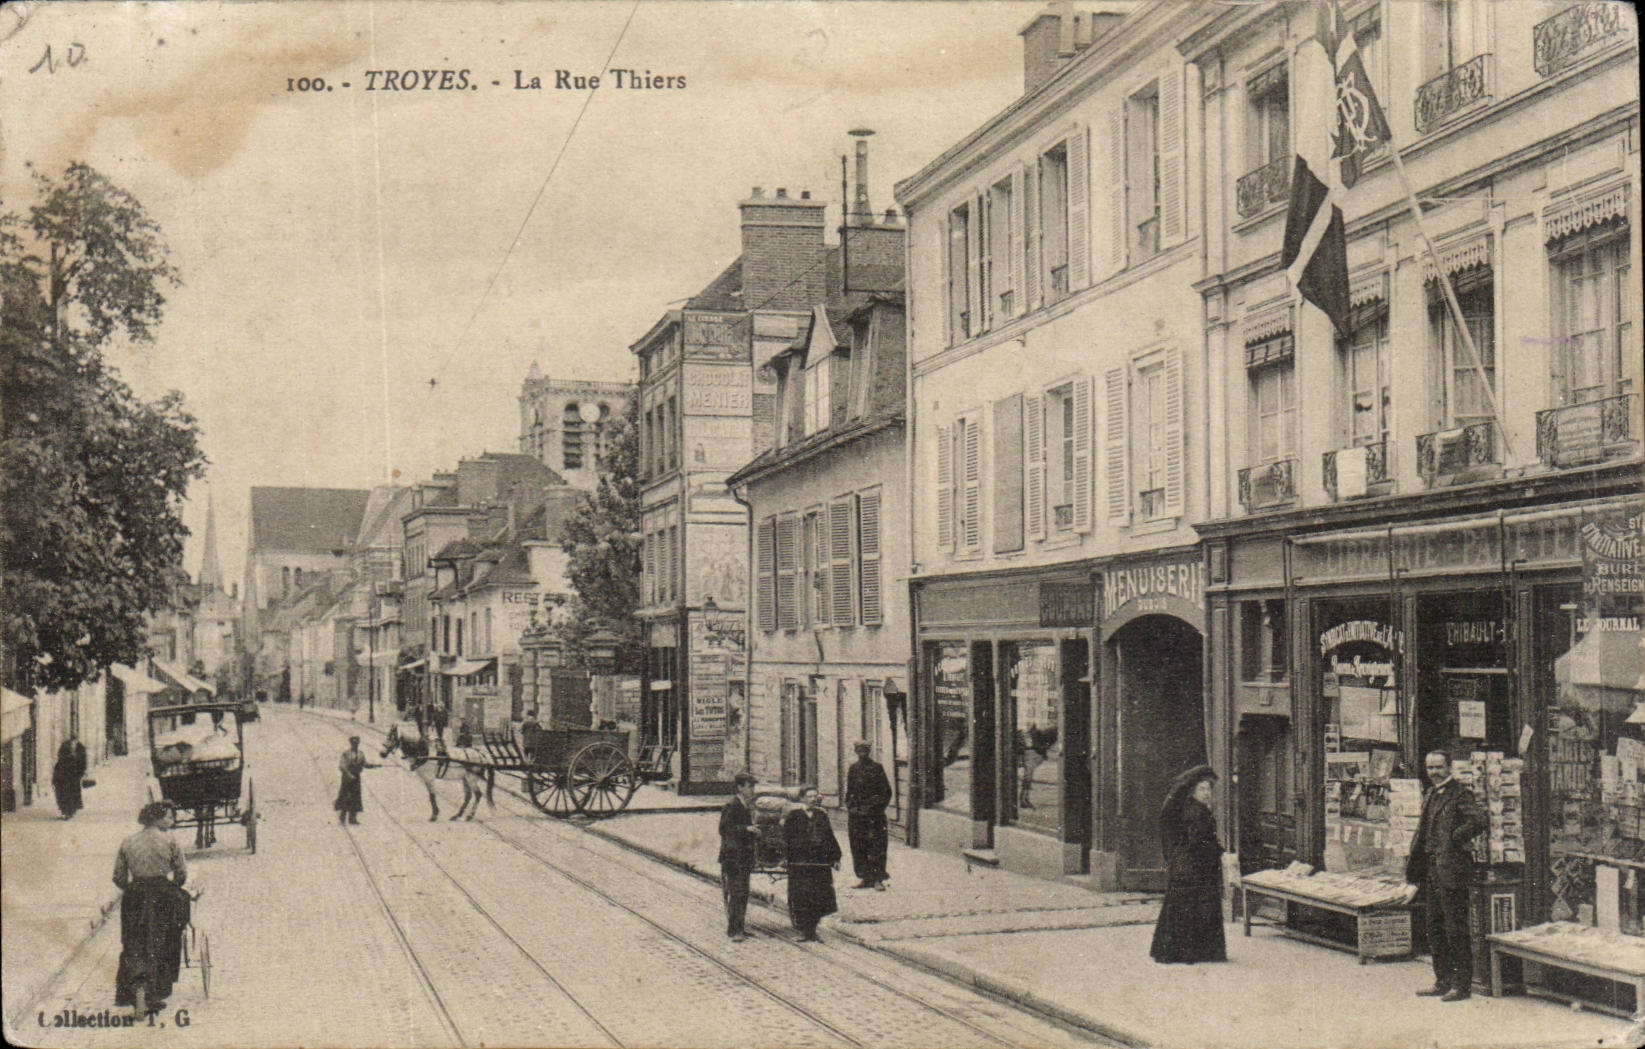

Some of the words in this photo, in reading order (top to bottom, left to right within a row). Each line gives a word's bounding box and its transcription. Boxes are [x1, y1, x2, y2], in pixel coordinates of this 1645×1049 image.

[687, 371, 750, 388] CHOCOLAT
[687, 390, 750, 410] MENIER
[1104, 561, 1206, 620] MENUISERIE
[1446, 621, 1496, 646] THIBAULT
